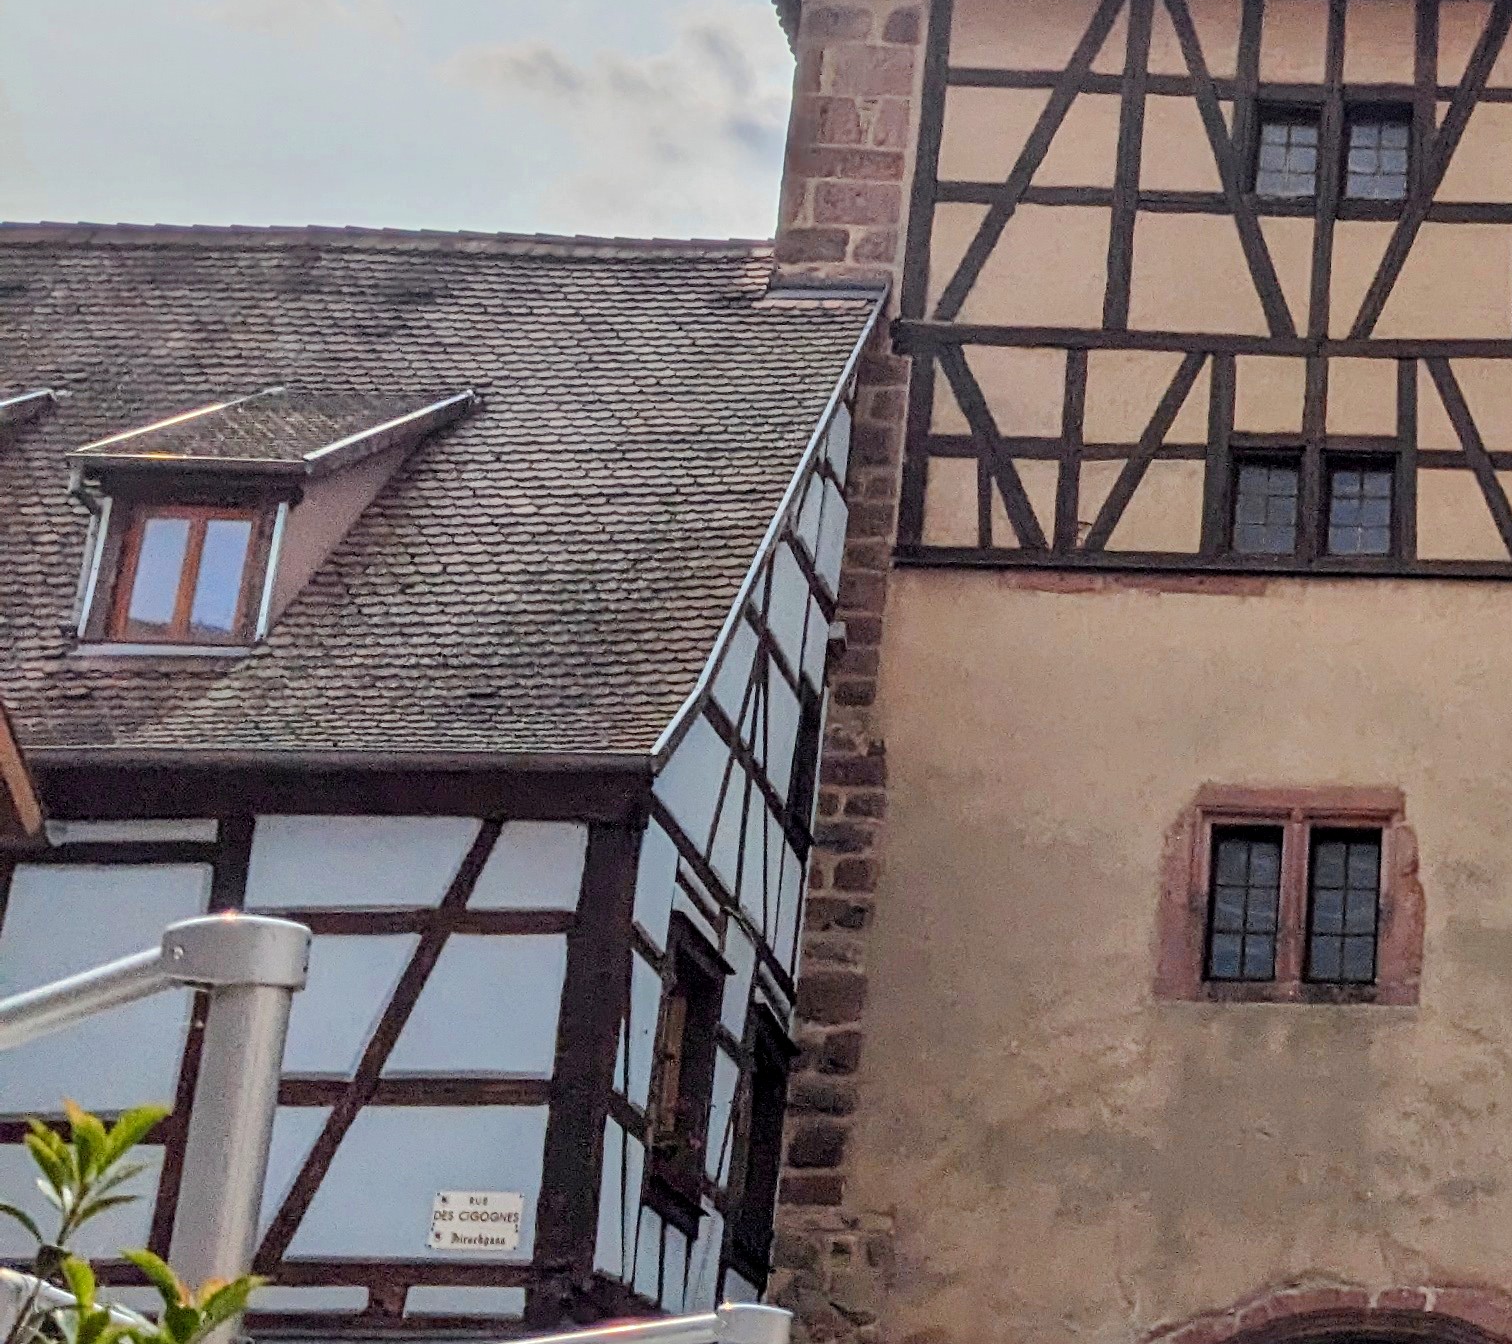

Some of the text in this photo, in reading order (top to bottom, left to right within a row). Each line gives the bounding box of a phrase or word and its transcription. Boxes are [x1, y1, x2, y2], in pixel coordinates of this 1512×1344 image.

[469, 1196, 489, 1206] RUE
[433, 1210, 520, 1223] DES CIGOGNES
